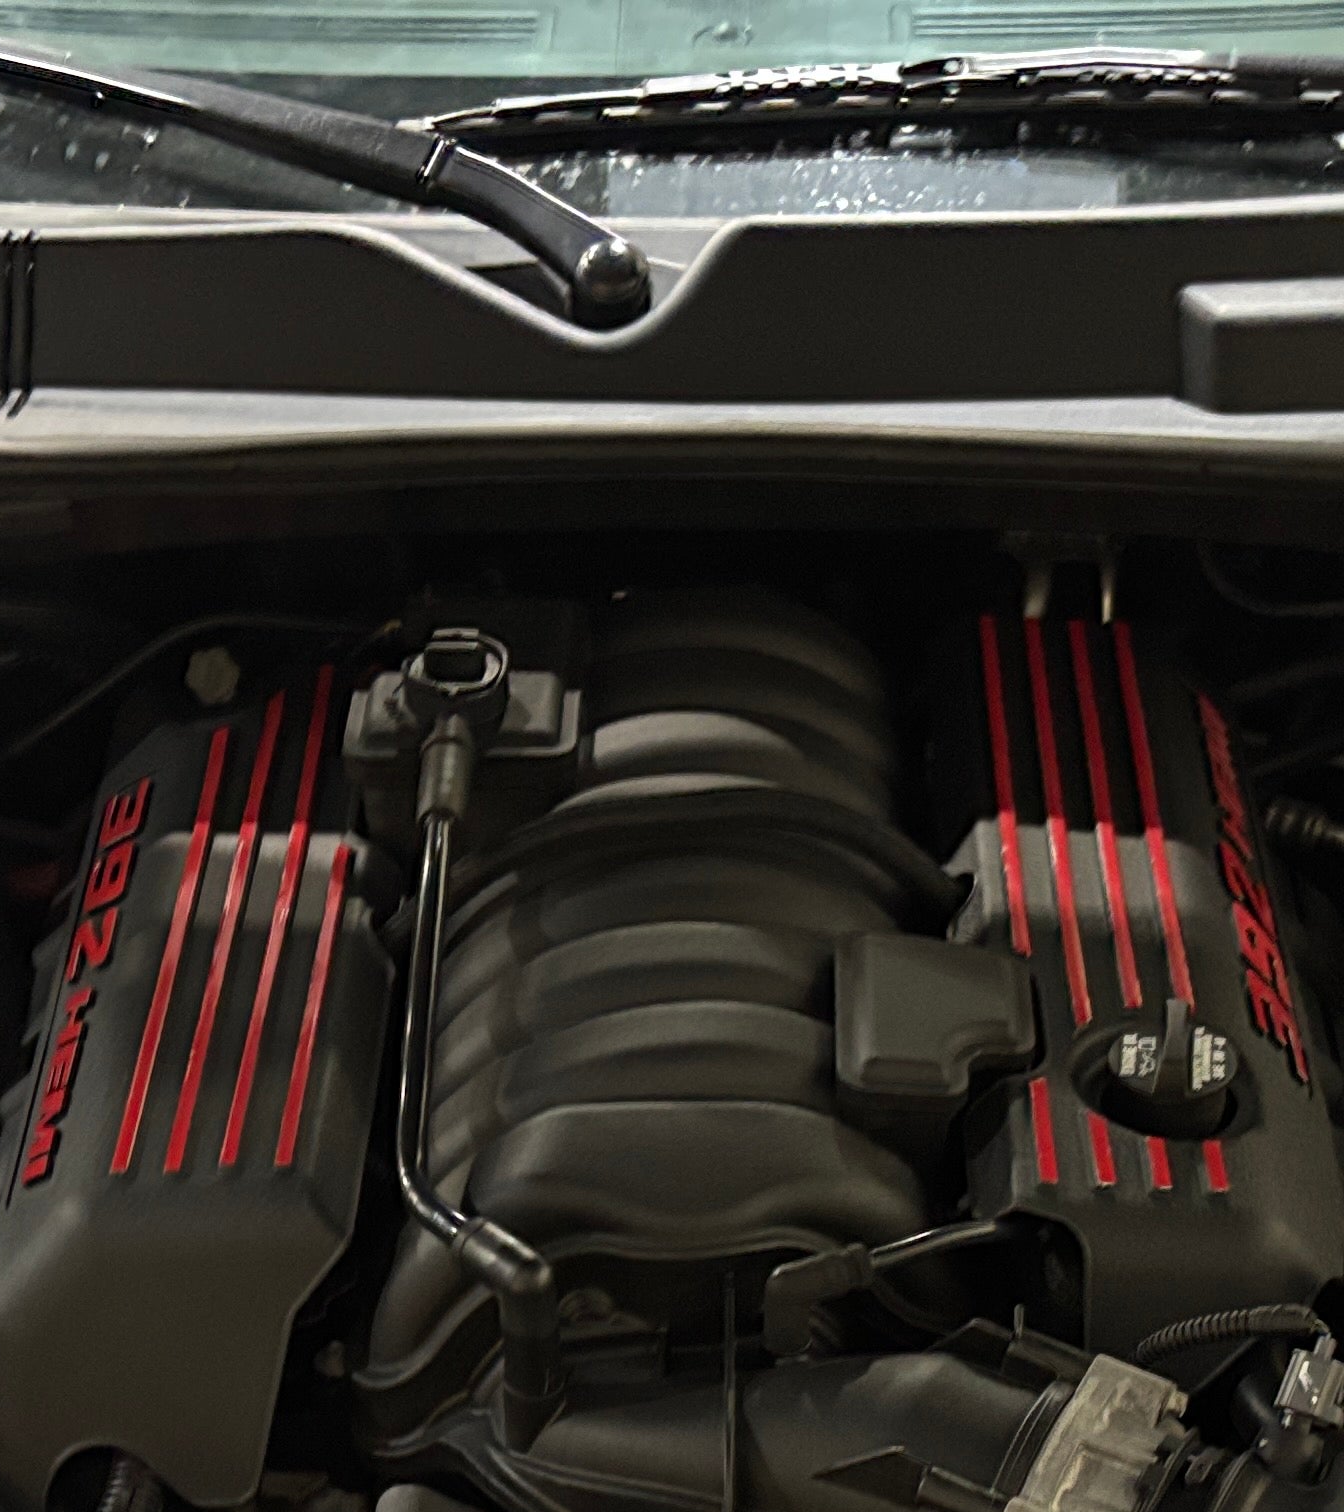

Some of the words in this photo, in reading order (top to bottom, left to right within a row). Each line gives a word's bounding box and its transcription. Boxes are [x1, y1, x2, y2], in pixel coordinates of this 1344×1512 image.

[65, 775, 153, 983] 392
[1217, 840, 1311, 1086] 392
[22, 986, 96, 1187] HEMI
